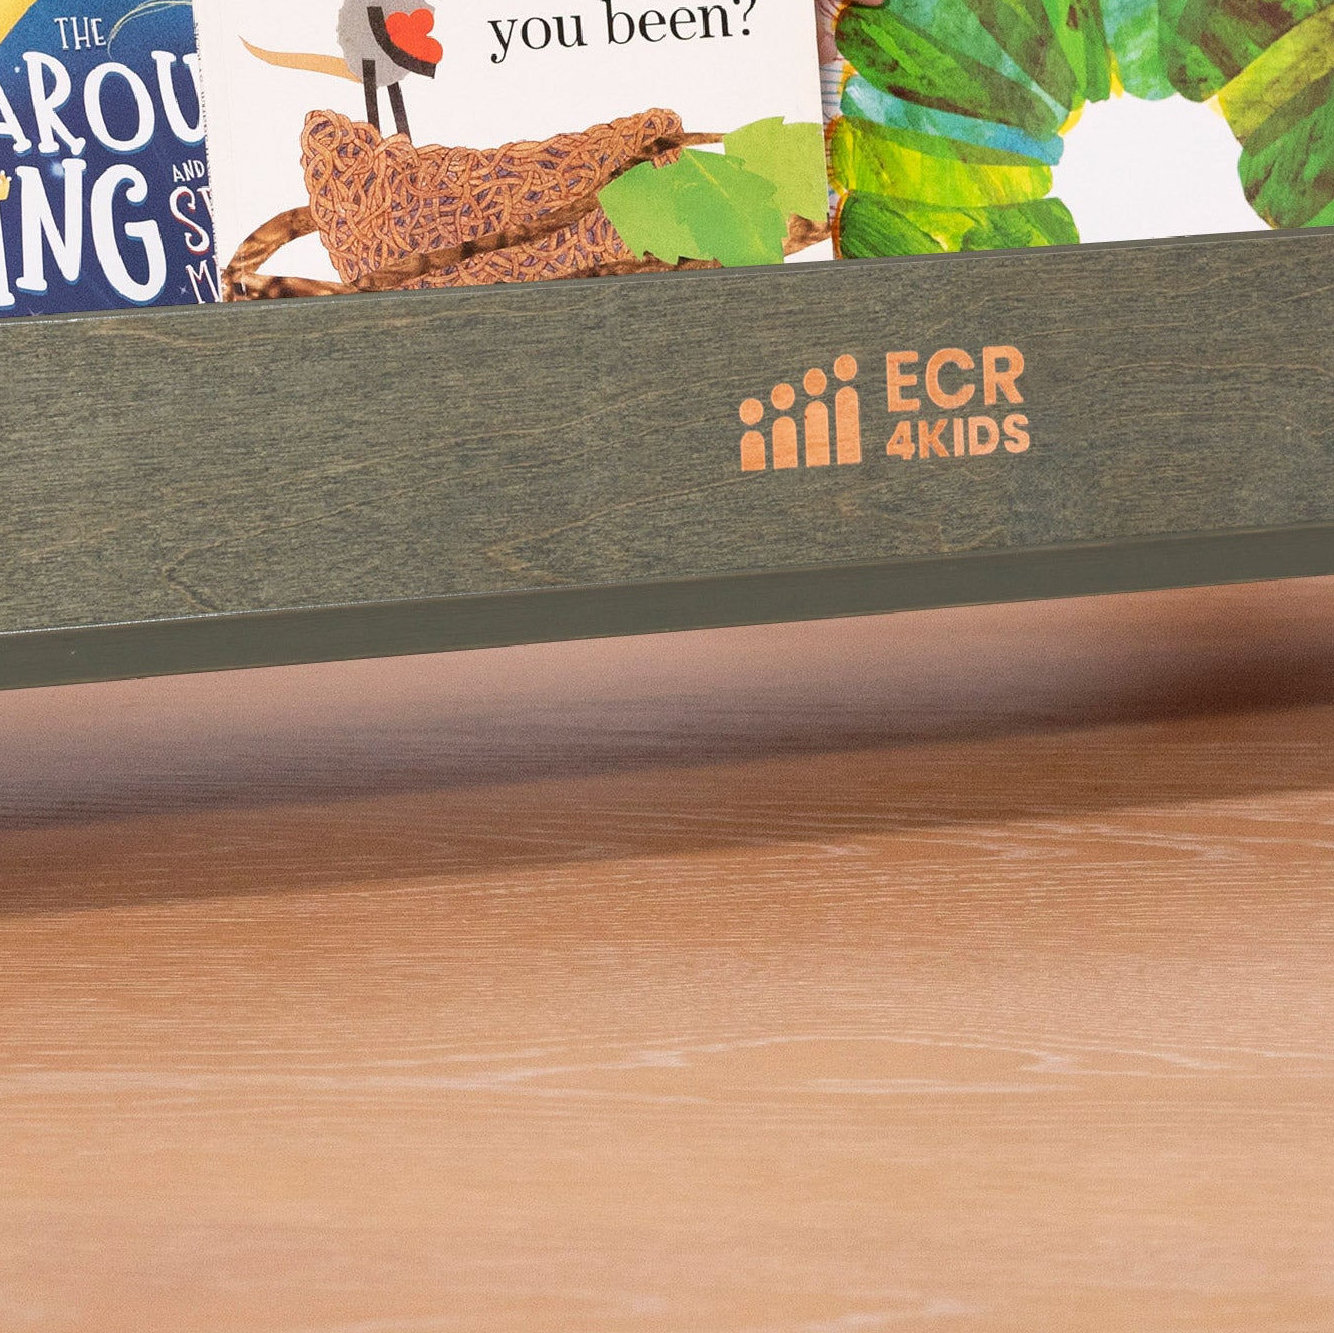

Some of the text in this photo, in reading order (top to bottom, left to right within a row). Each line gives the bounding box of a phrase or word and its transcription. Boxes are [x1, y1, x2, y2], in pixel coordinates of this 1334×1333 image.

[54, 16, 108, 52] THE
[487, 4, 585, 64] you
[172, 159, 205, 183] AND
[885, 345, 1025, 412] ECR
[886, 414, 1030, 460] 4KIDS
